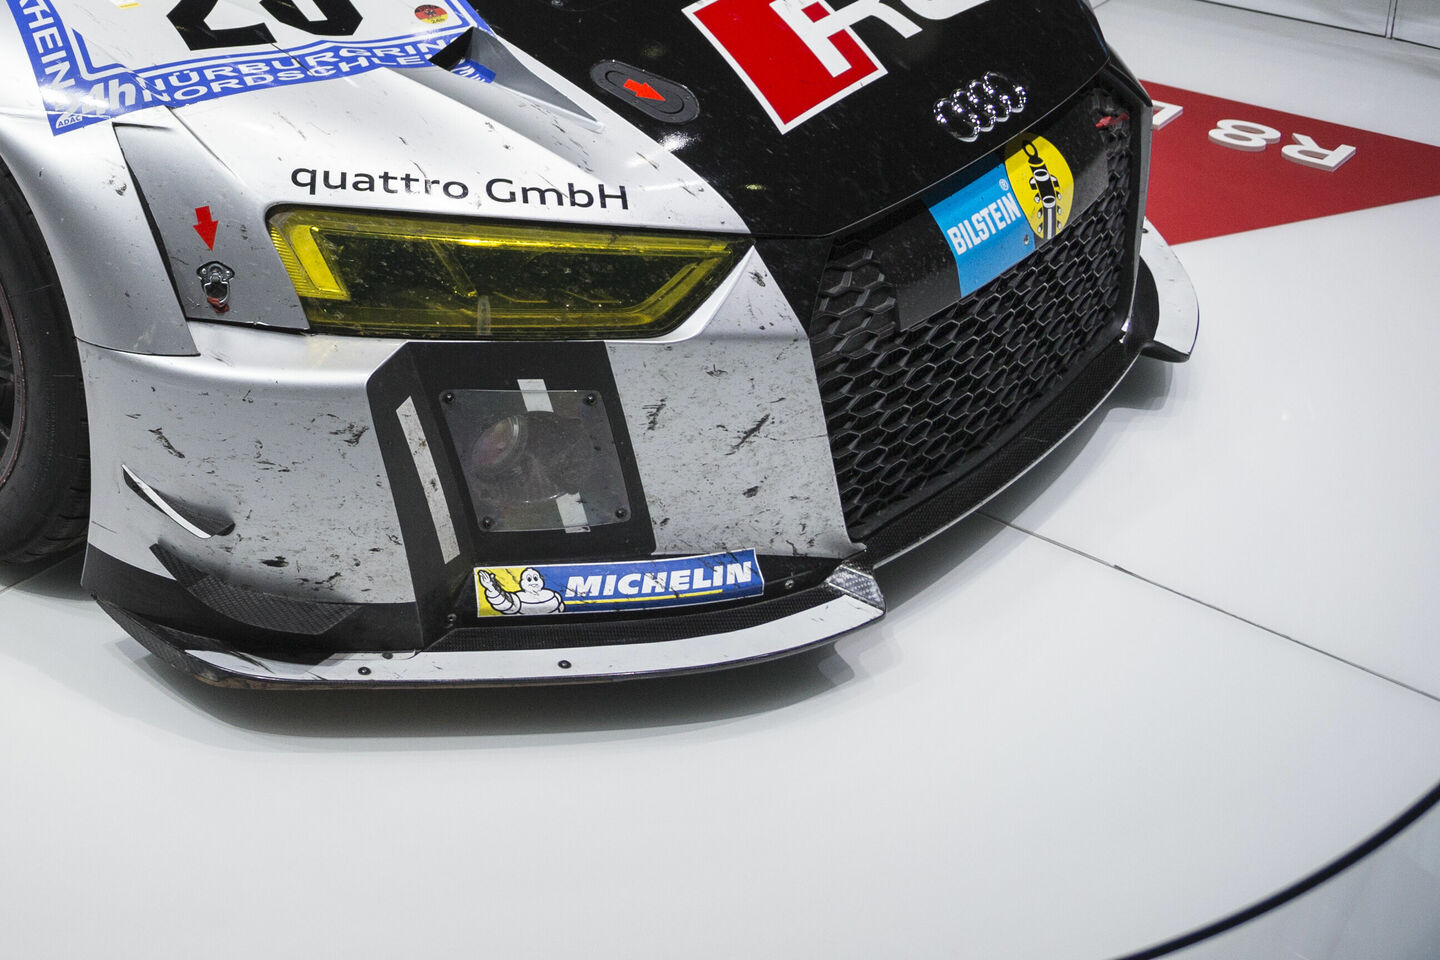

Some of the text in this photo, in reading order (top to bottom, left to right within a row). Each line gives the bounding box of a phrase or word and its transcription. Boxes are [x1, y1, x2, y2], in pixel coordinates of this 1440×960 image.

[137, 36, 458, 90] NÜRBURGRIN
[142, 54, 432, 103] NORDSCHLE
[1208, 119, 1357, 173] R8
[290, 167, 629, 210] quattro GmbH
[946, 192, 1022, 256] BILSTEIN
[564, 560, 752, 598] MICHELIN
